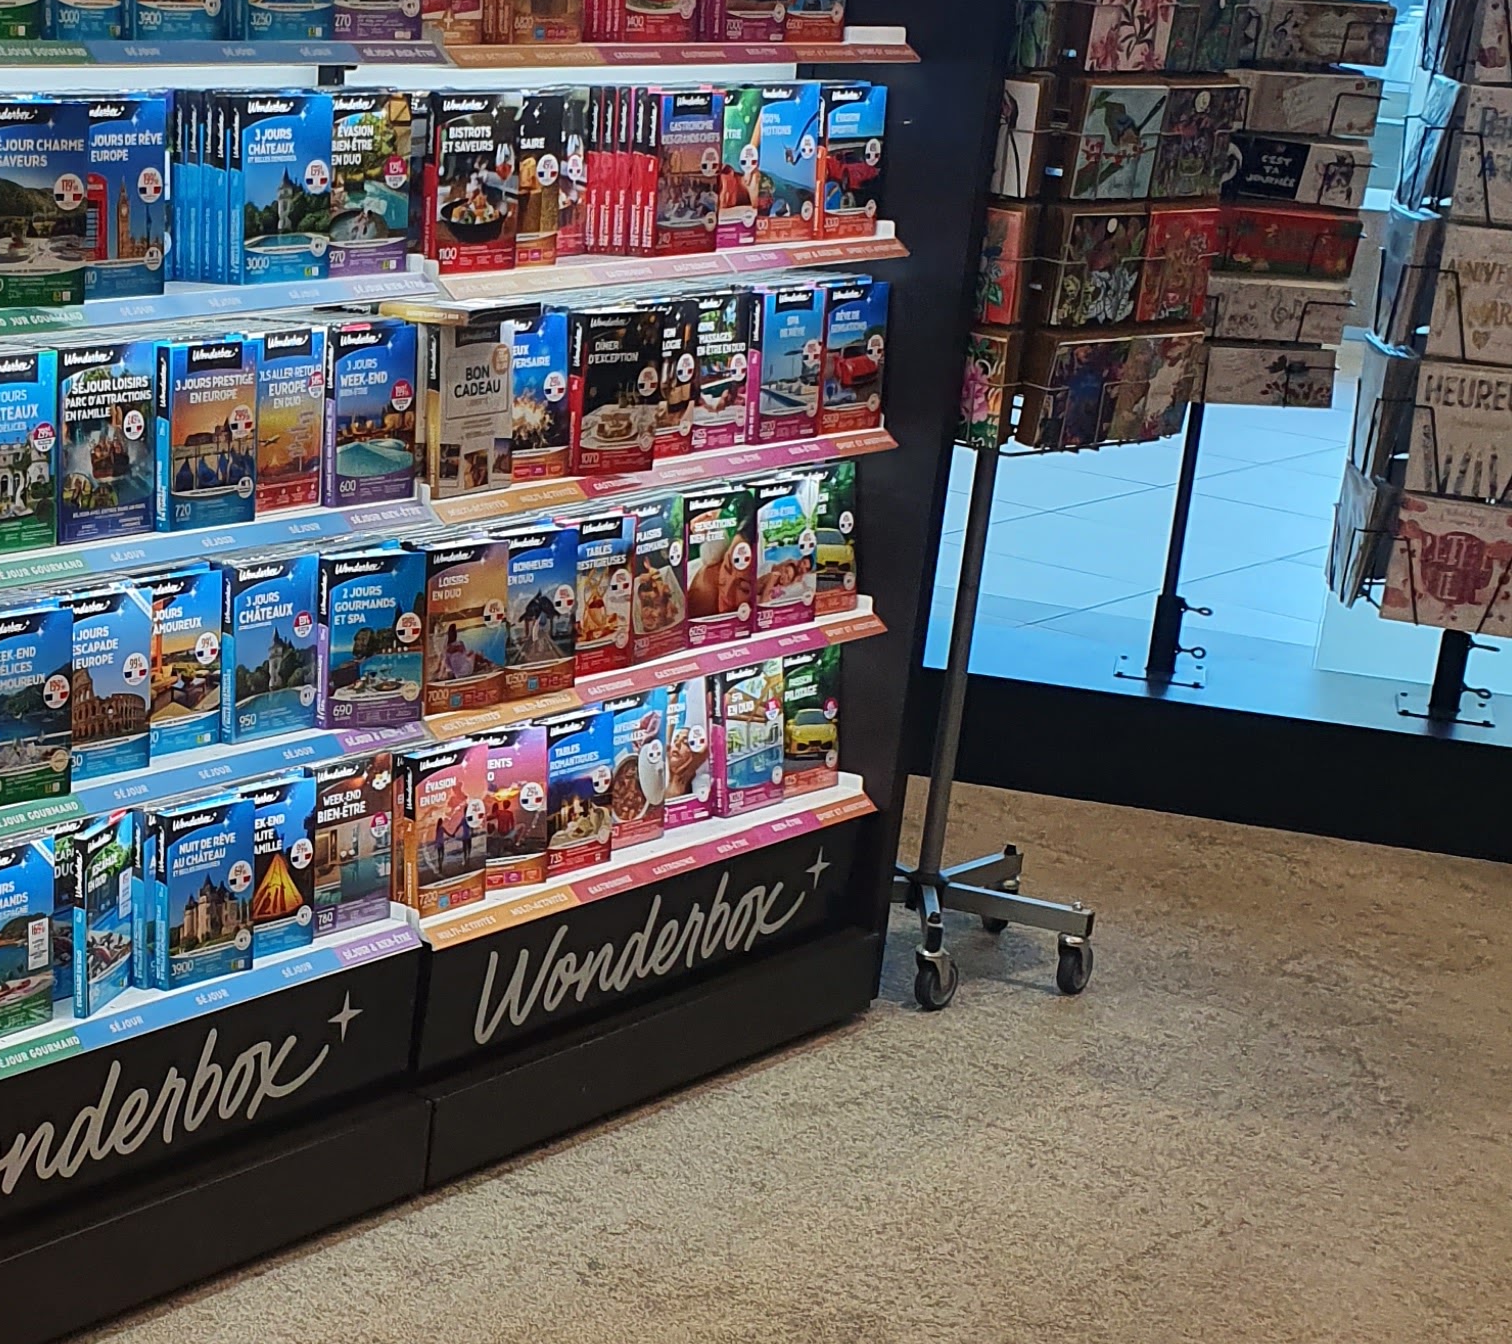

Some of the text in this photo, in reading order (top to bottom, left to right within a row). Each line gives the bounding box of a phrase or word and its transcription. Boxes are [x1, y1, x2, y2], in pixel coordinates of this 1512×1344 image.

[449, 126, 492, 140] BISTROTS
[37, 137, 84, 152] CHARME
[465, 364, 489, 381] BON
[110, 374, 148, 391] LOISIRS
[454, 378, 501, 399] CADEAU
[79, 405, 111, 421] FAMILLE
[334, 596, 396, 611] GOURMANDS
[317, 800, 366, 824] BIEN-ÊTRE
[473, 874, 801, 1047] Wonderbox
